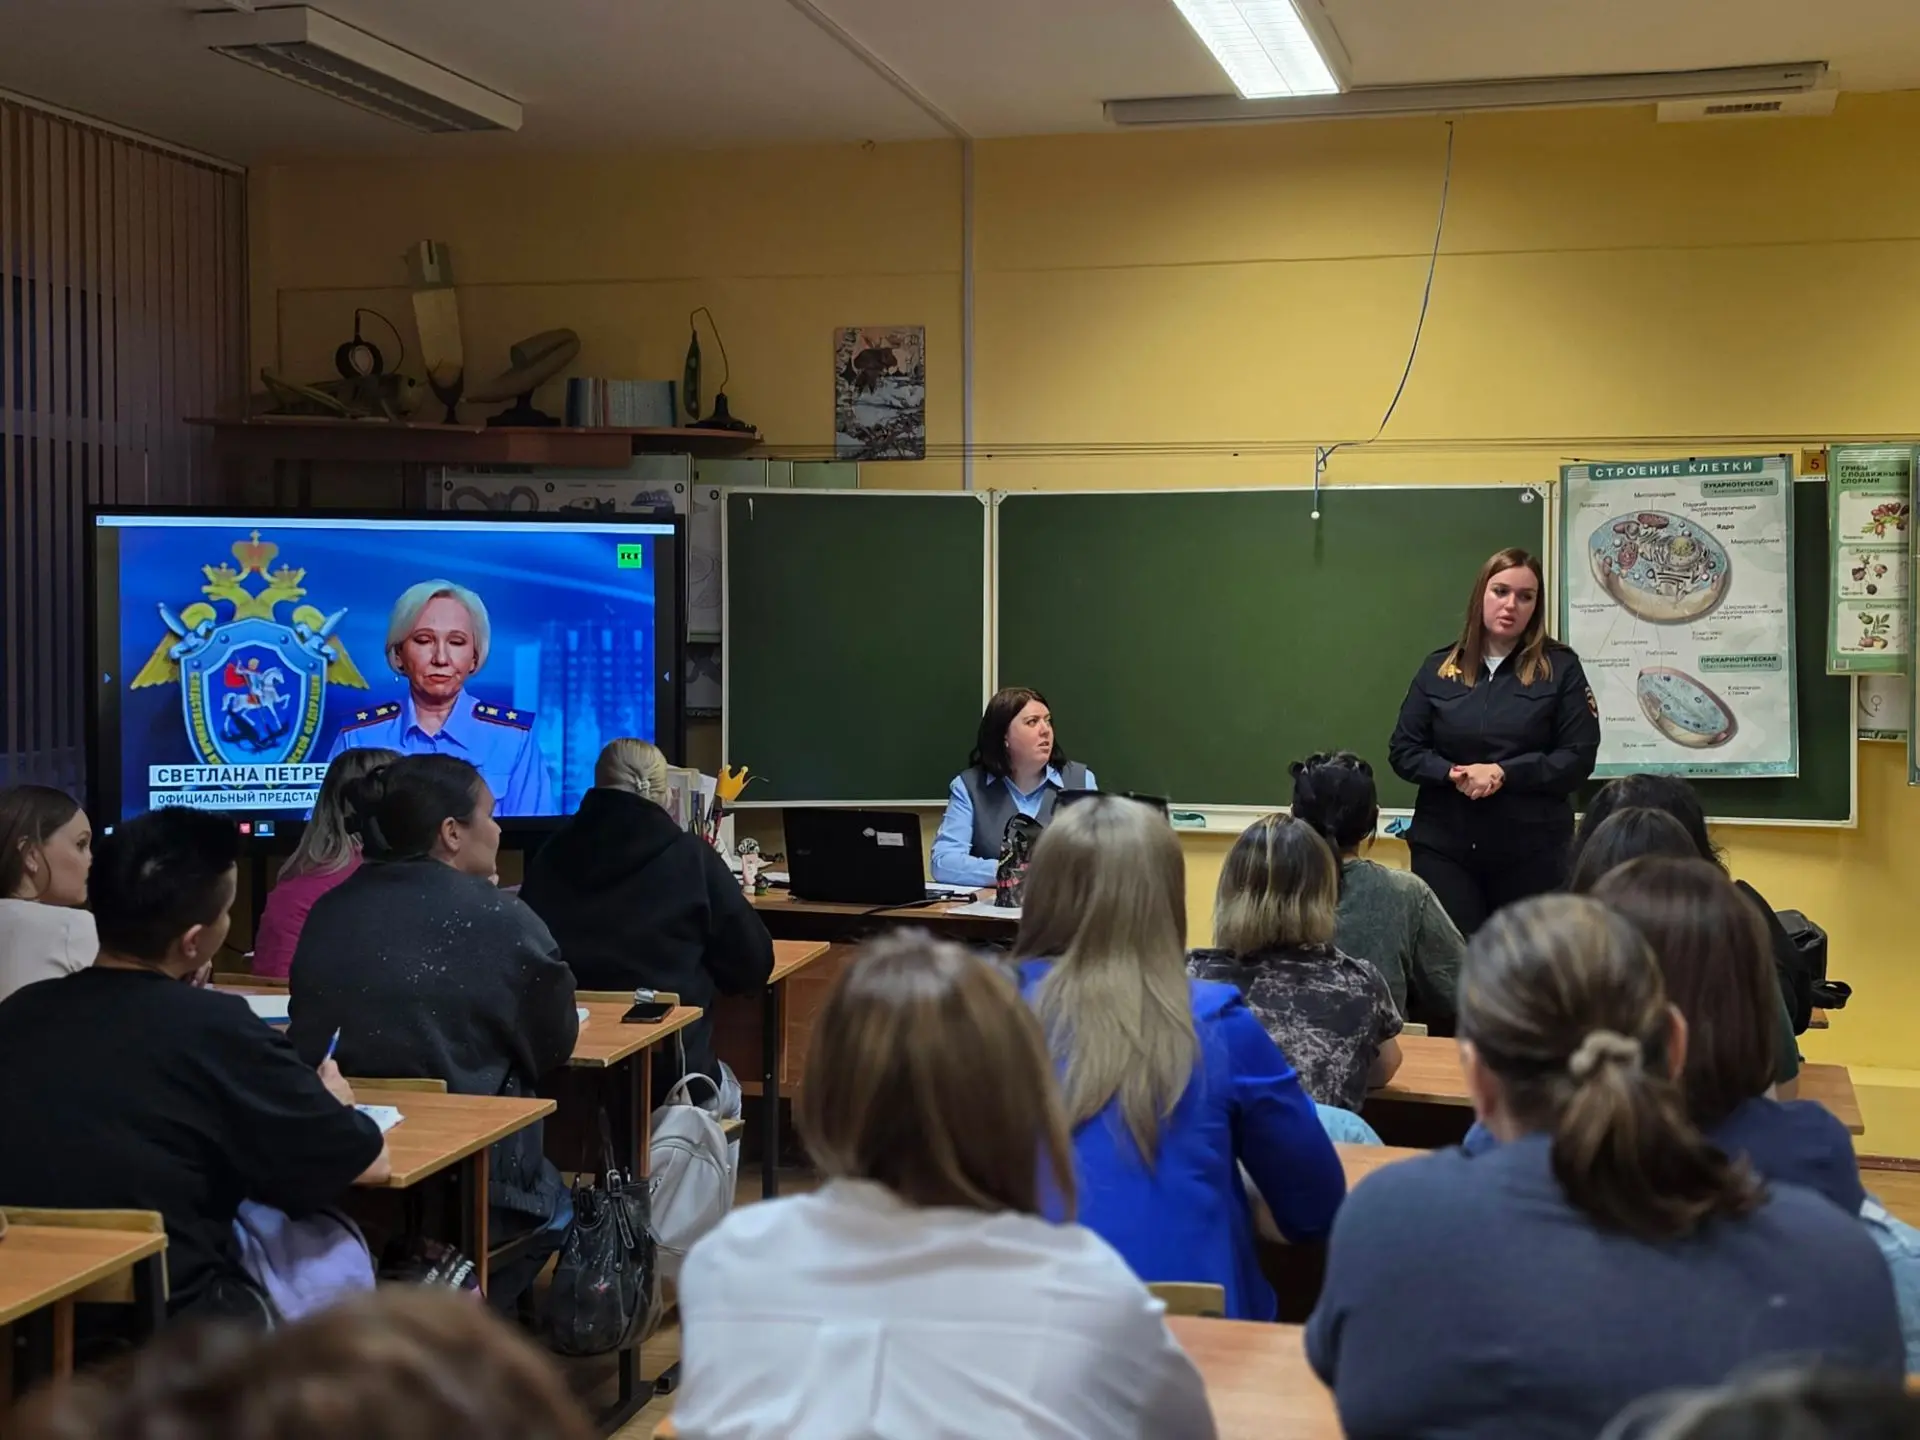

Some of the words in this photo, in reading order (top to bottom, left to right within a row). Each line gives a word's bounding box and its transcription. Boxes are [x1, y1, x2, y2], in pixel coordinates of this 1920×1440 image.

[1595, 464, 1680, 478] СТРОЕНИЕ
[1689, 461, 1752, 473] КЛЕТКИ
[1811, 458, 1820, 470] 5
[1704, 480, 1773, 488] ЭУКАРИОТИЧЕСКАЯ
[1701, 655, 1777, 663] ПРОКАРИОТИЧЕСКАЯ
[157, 768, 259, 783] СВЕТЛАНА
[157, 793, 255, 804] ОФИЦИАЛЬНЫЙ
